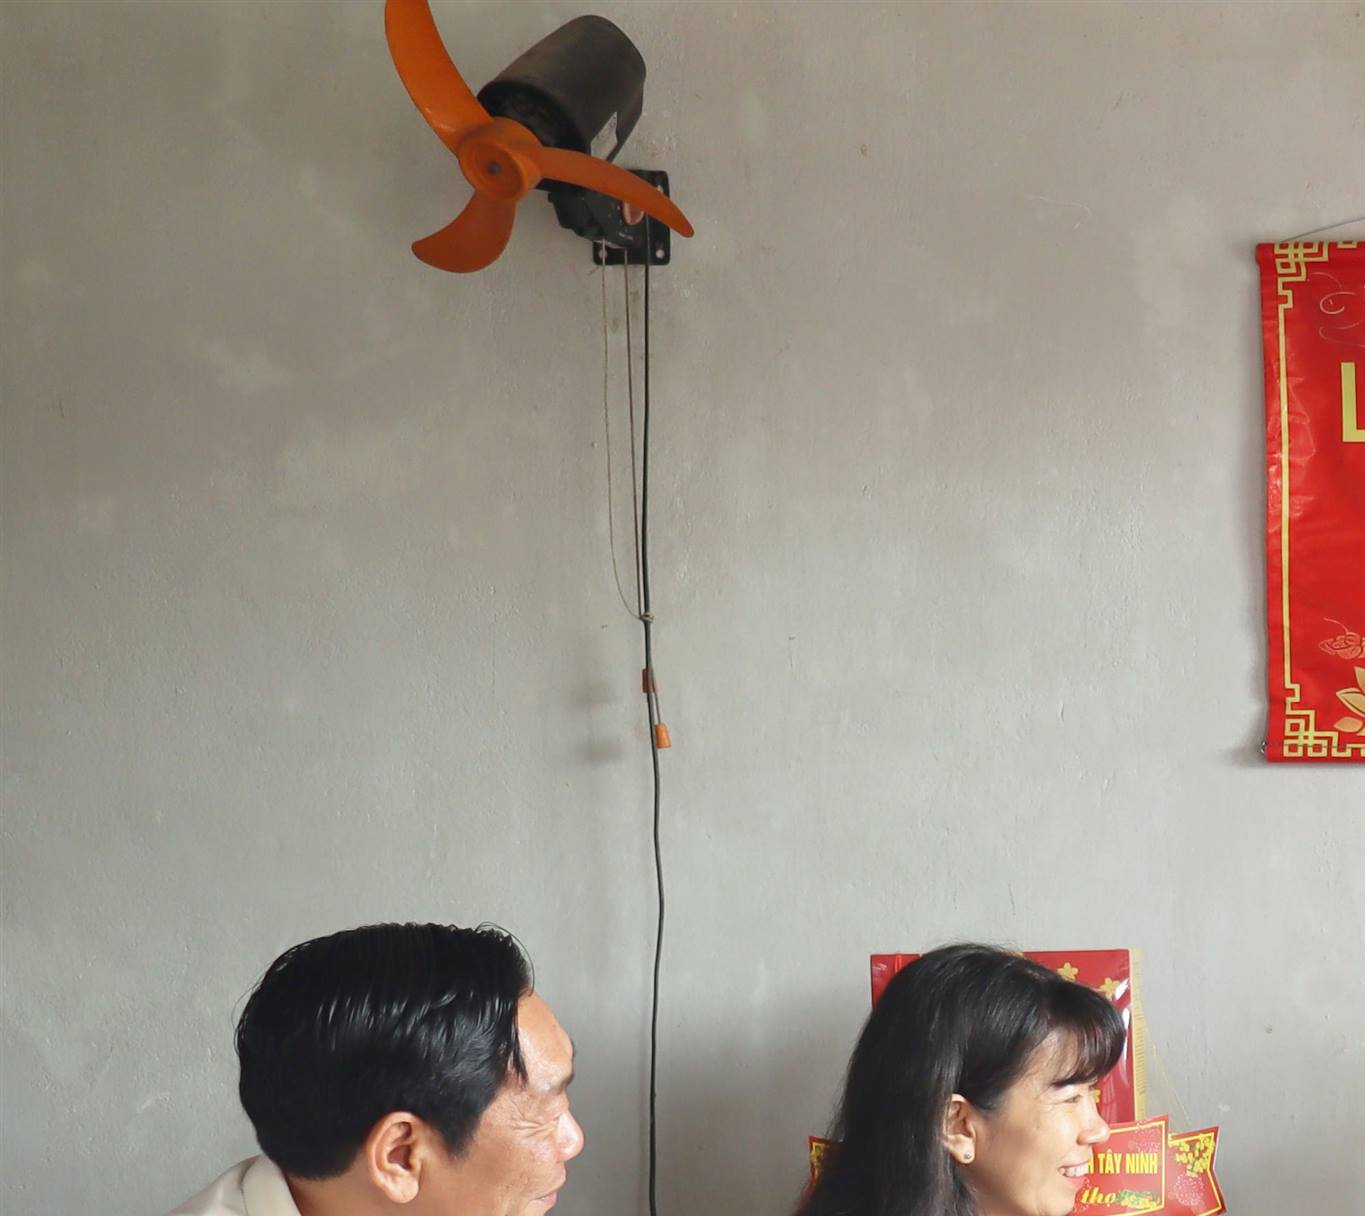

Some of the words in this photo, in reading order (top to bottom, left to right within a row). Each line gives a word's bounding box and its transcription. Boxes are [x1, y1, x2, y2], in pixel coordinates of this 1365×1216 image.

[1097, 1148, 1123, 1174] TÂY
[1125, 1151, 1158, 1174] NINH
[1081, 1187, 1117, 1207] thọ
